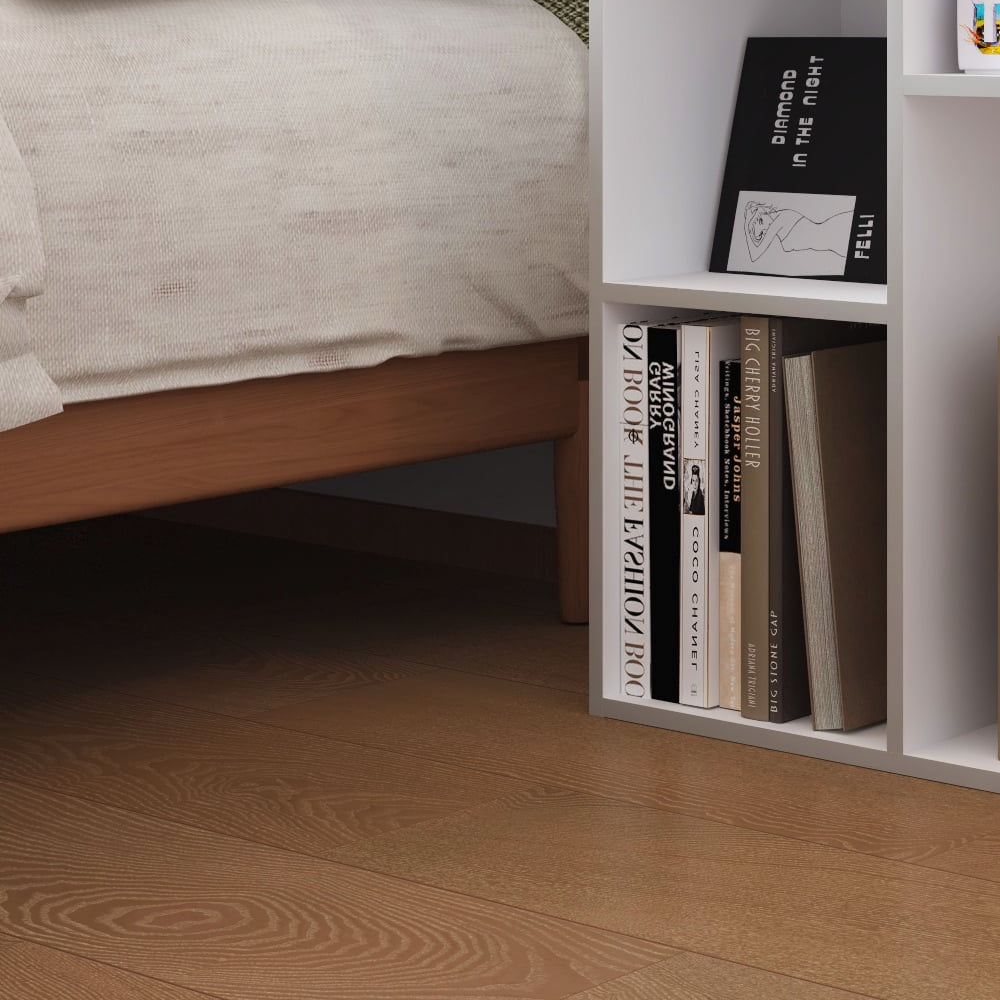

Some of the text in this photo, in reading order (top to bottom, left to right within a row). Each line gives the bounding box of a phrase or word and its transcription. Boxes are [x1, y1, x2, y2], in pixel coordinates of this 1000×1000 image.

[802, 55, 825, 106] NIGHT
[771, 69, 797, 145] DIAMOND
[795, 117, 814, 145] THE
[854, 214, 875, 260] FELLI
[744, 328, 761, 468] BIG CHERRY HOLLER
[731, 395, 742, 504] Jasper Johns
[770, 610, 778, 637] GAP
[770, 690, 778, 713] BIG
